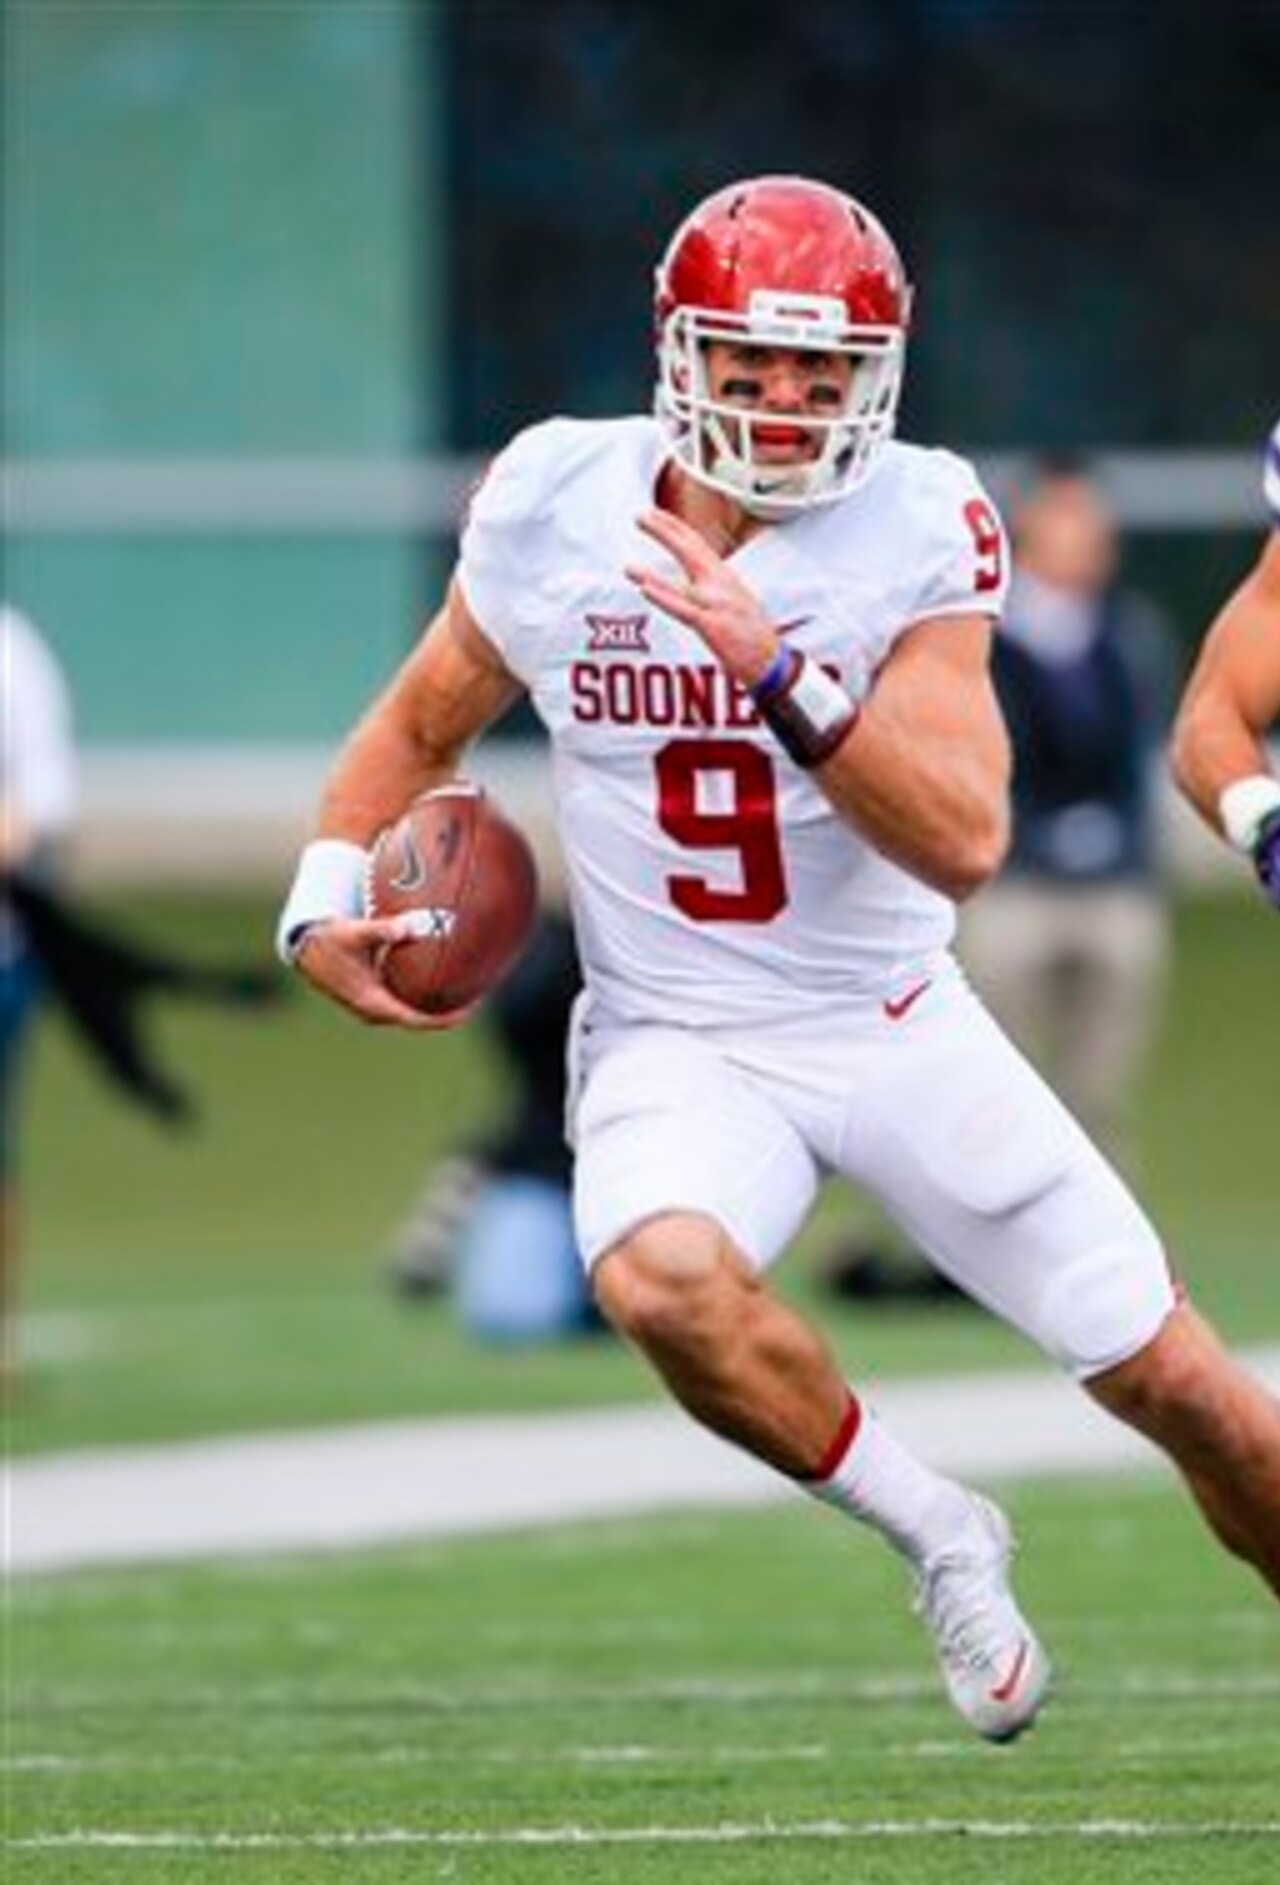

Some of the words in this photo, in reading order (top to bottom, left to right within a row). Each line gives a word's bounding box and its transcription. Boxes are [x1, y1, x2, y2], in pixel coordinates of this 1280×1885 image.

[962, 498, 1001, 592] 9
[572, 660, 841, 728] SOONE
[654, 739, 788, 924] 9
